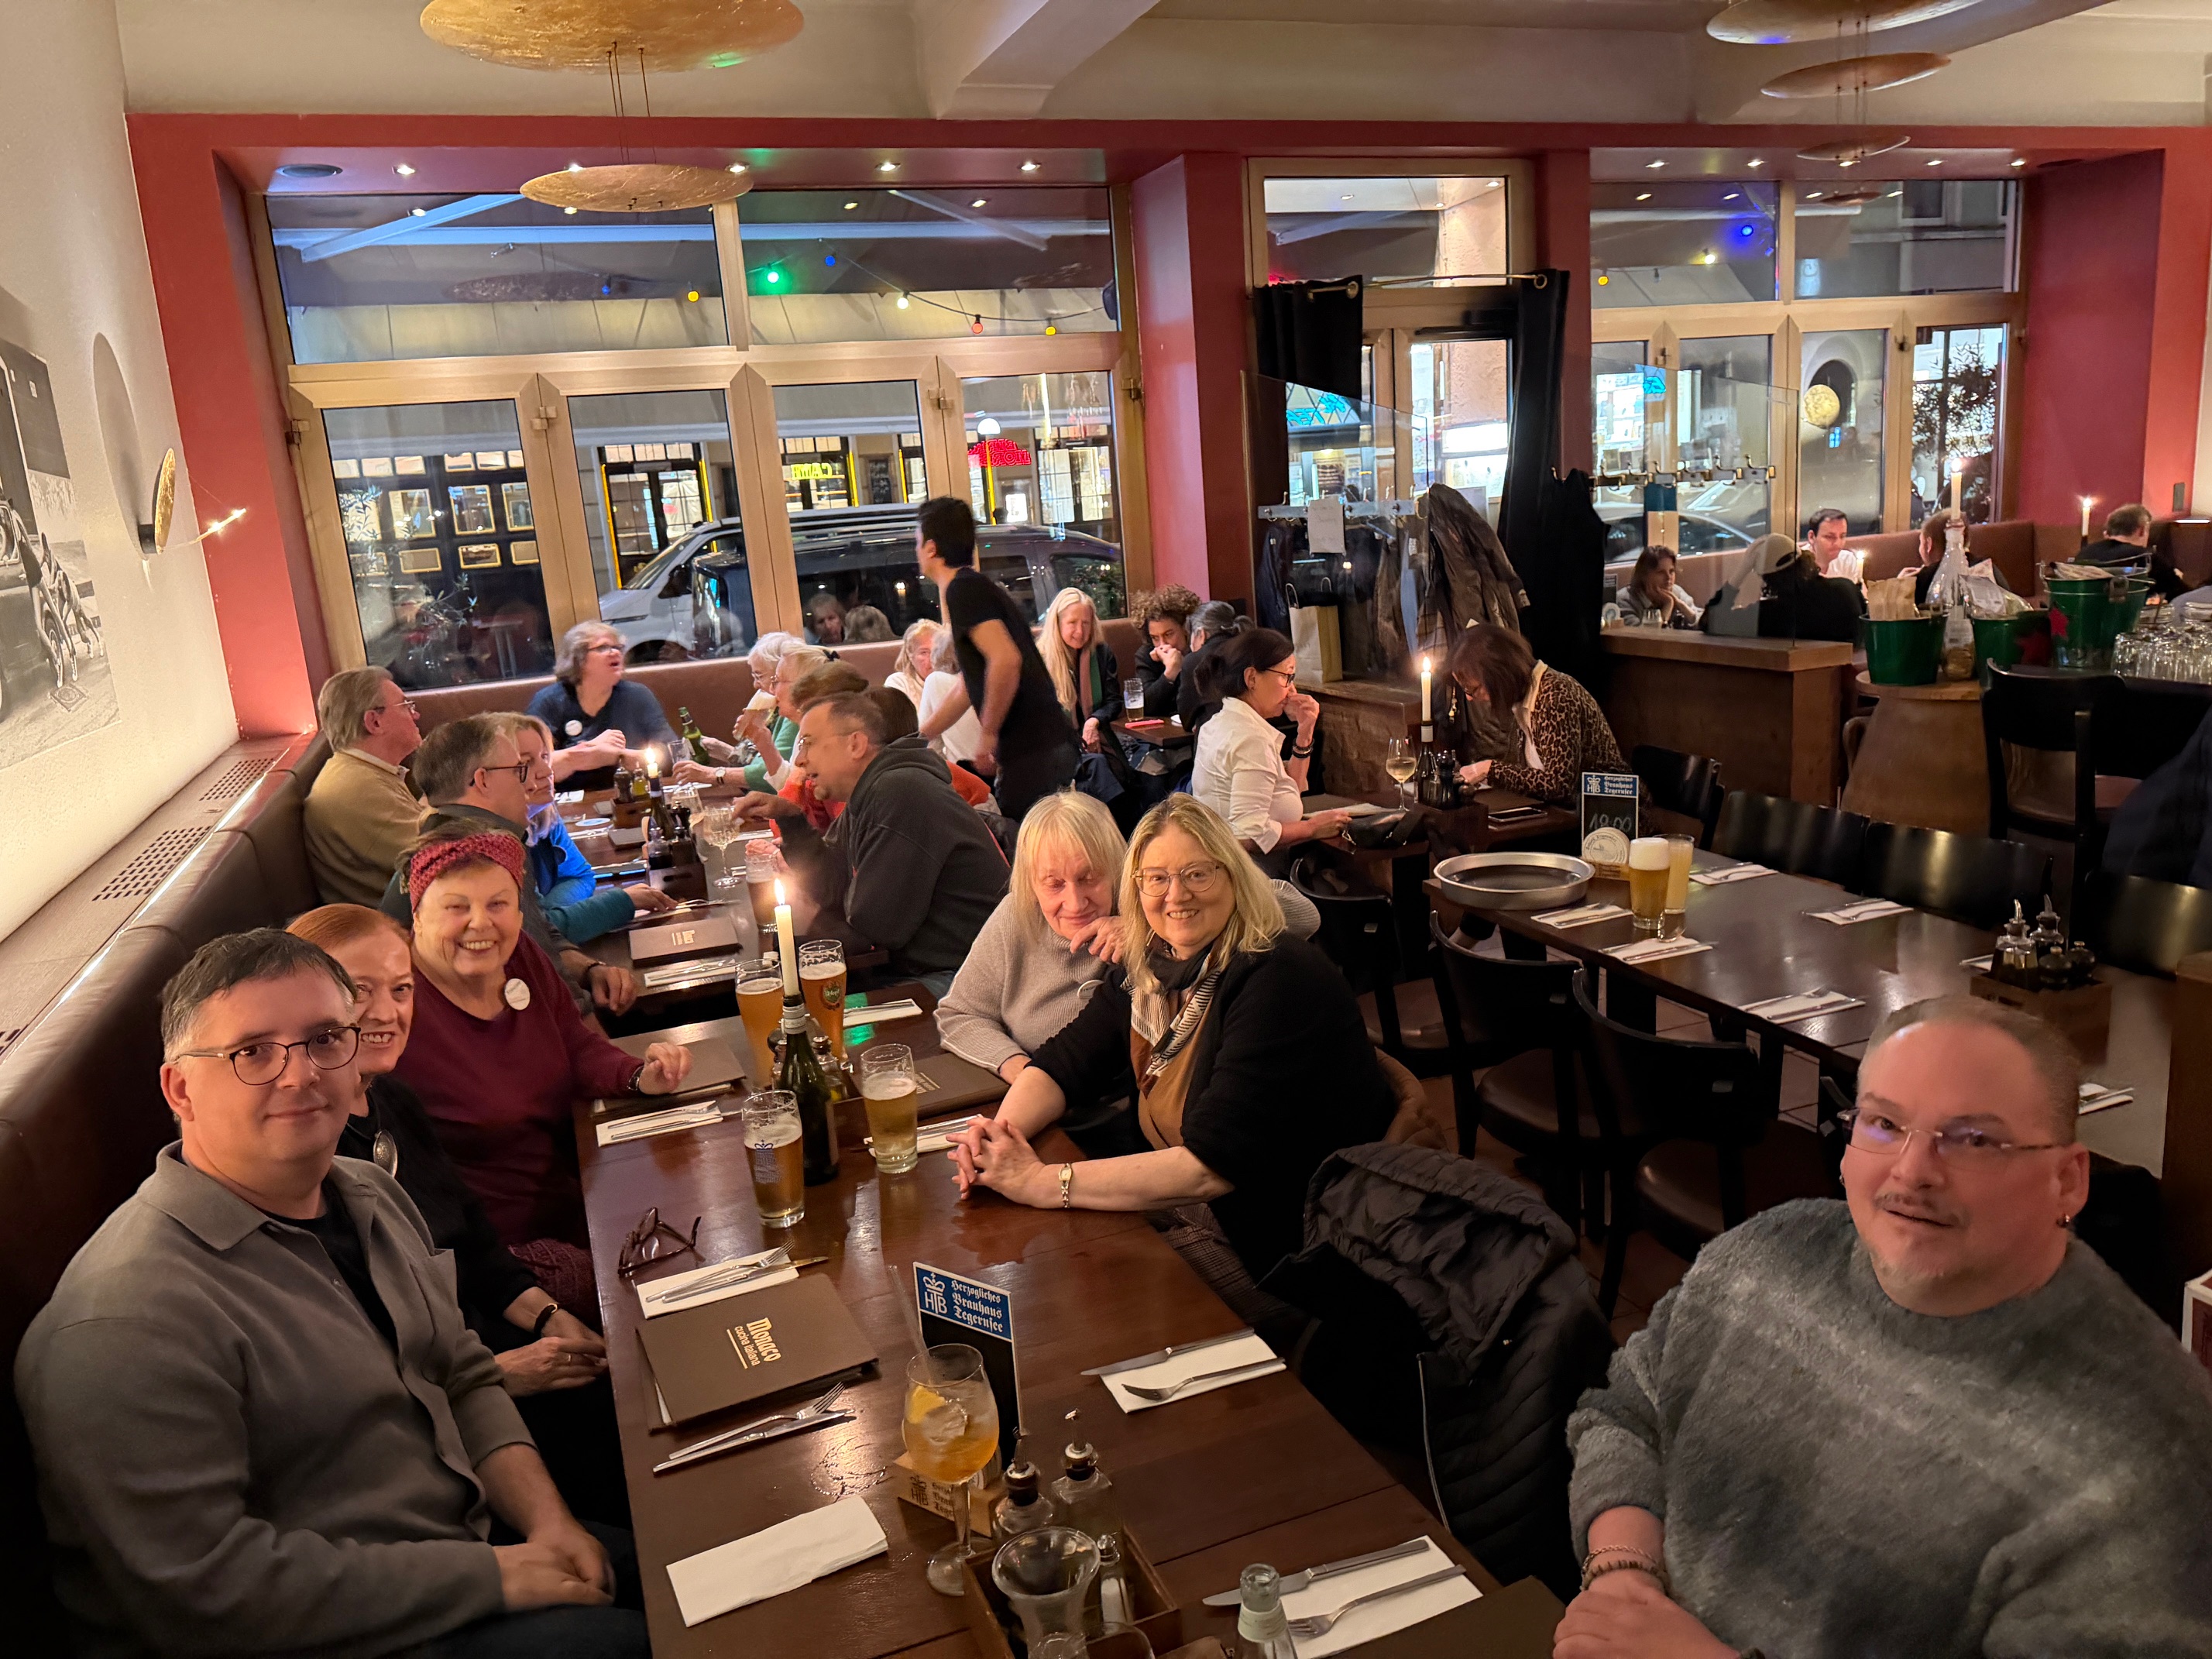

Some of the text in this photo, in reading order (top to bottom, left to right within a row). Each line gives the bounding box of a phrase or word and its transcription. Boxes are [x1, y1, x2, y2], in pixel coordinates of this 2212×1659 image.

[951, 1280, 1001, 1304] Herzogliches
[952, 1293, 1002, 1319] Brauhaus
[734, 1326, 761, 1366] cucina italiana
